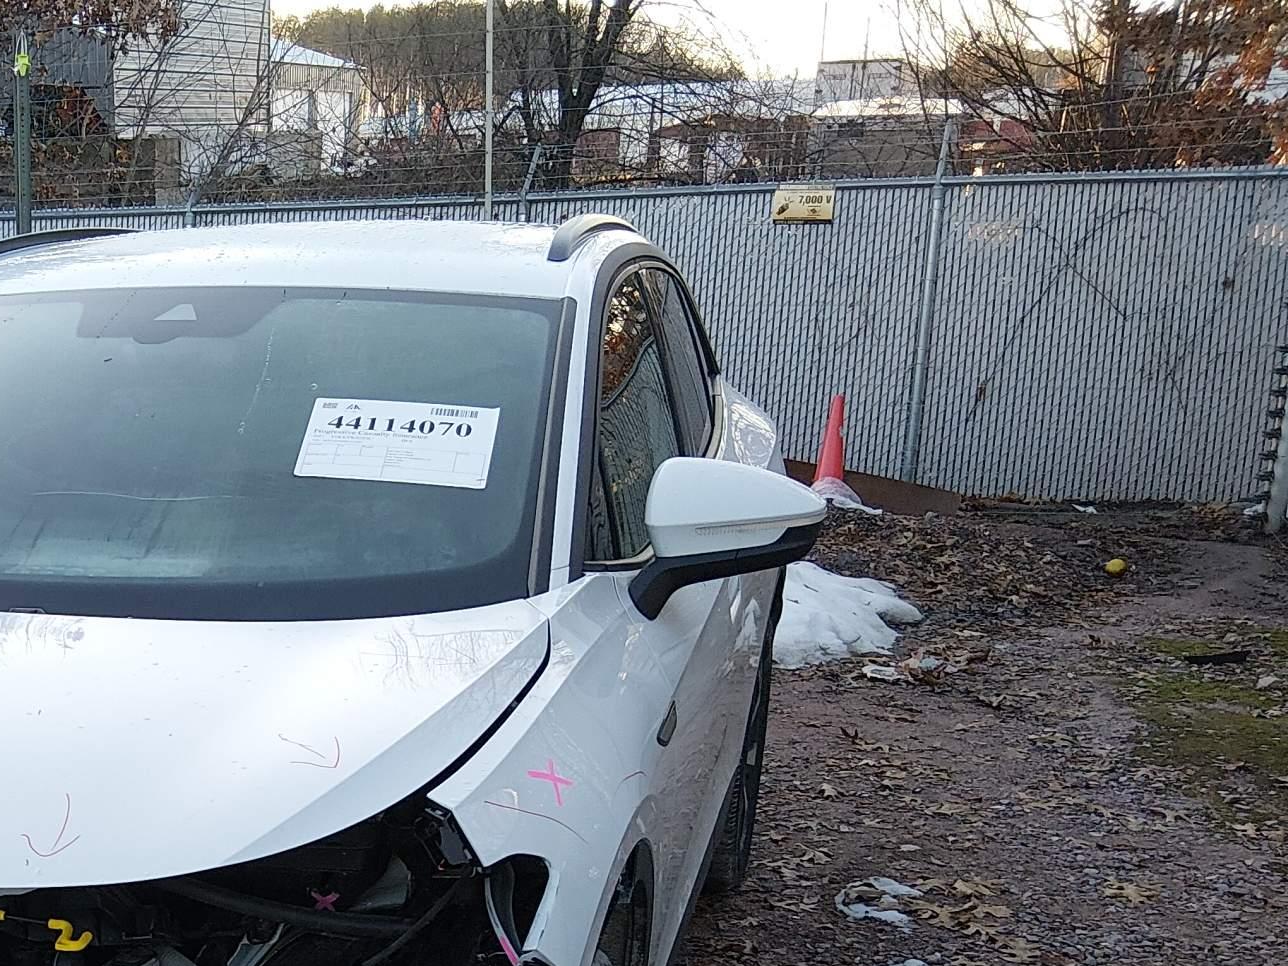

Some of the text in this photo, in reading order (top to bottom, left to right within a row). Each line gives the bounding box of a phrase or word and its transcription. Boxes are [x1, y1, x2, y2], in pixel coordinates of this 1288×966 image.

[798, 194, 832, 206] 7,000 V
[327, 415, 473, 438] 44114070
